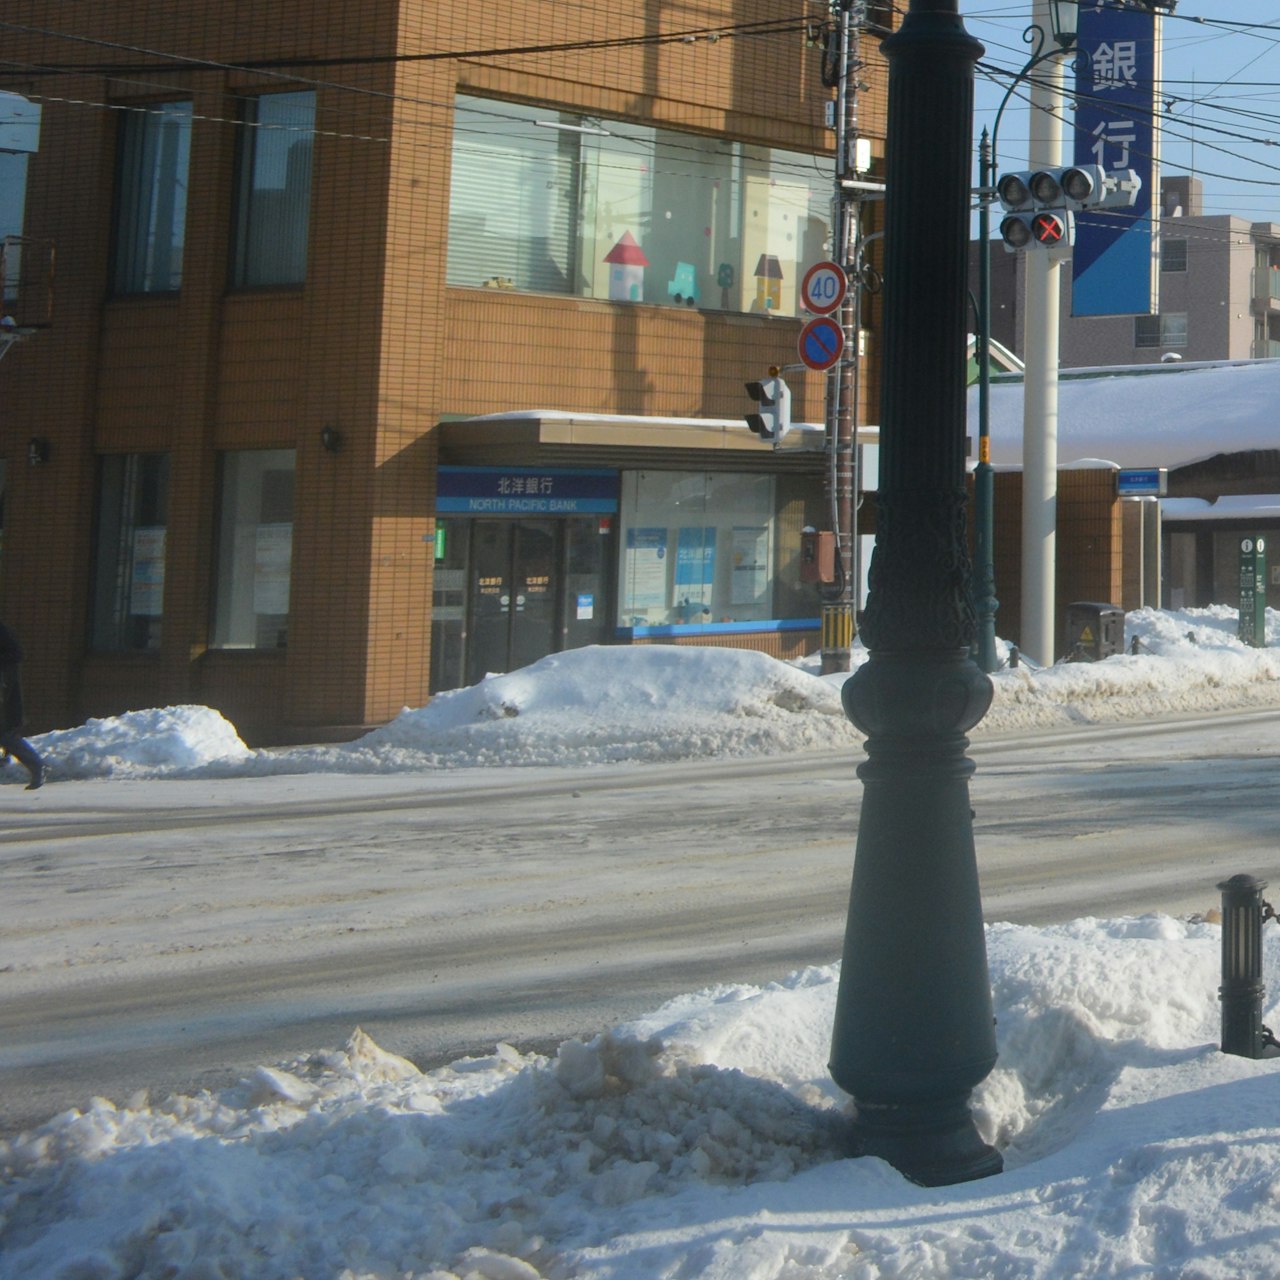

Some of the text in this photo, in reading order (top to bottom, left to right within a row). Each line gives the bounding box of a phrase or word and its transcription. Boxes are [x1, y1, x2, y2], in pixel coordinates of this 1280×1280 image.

[810, 275, 836, 300] 40
[497, 477, 553, 495] 北洋銀行
[469, 499, 577, 511] NORTH PACIFIC BANK
